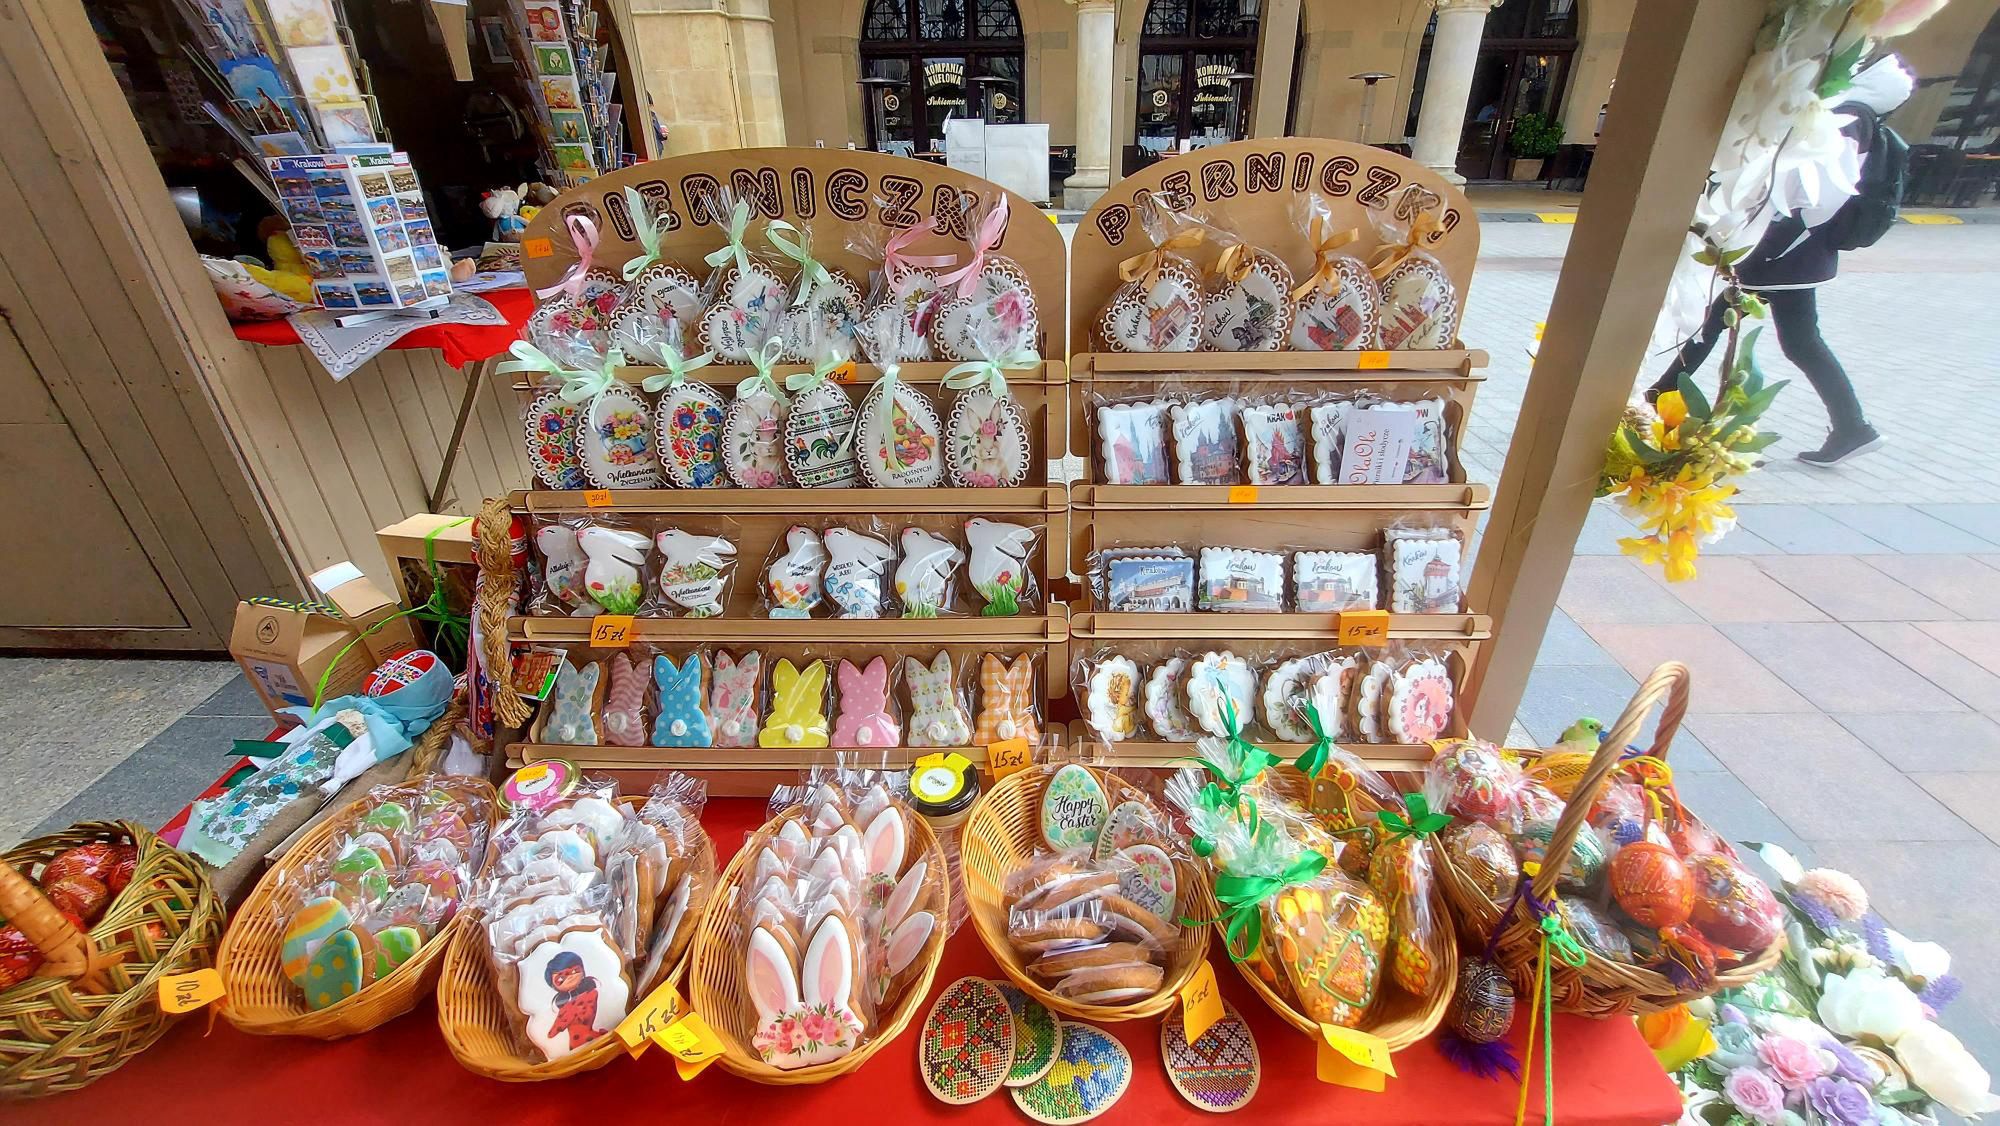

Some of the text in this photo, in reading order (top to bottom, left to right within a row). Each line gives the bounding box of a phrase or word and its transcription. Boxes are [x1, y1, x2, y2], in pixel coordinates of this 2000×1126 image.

[924, 63, 964, 76] KOMPANIA
[1196, 65, 1235, 78] KOMPANIA
[928, 73, 961, 86] KUFLOWA
[1197, 75, 1232, 88] KUFLOWA
[892, 465, 932, 480] RADOSNYCH
[1054, 794, 1102, 817] Happy
[1052, 813, 1098, 830] Easter
[639, 1007, 657, 1040] 15
